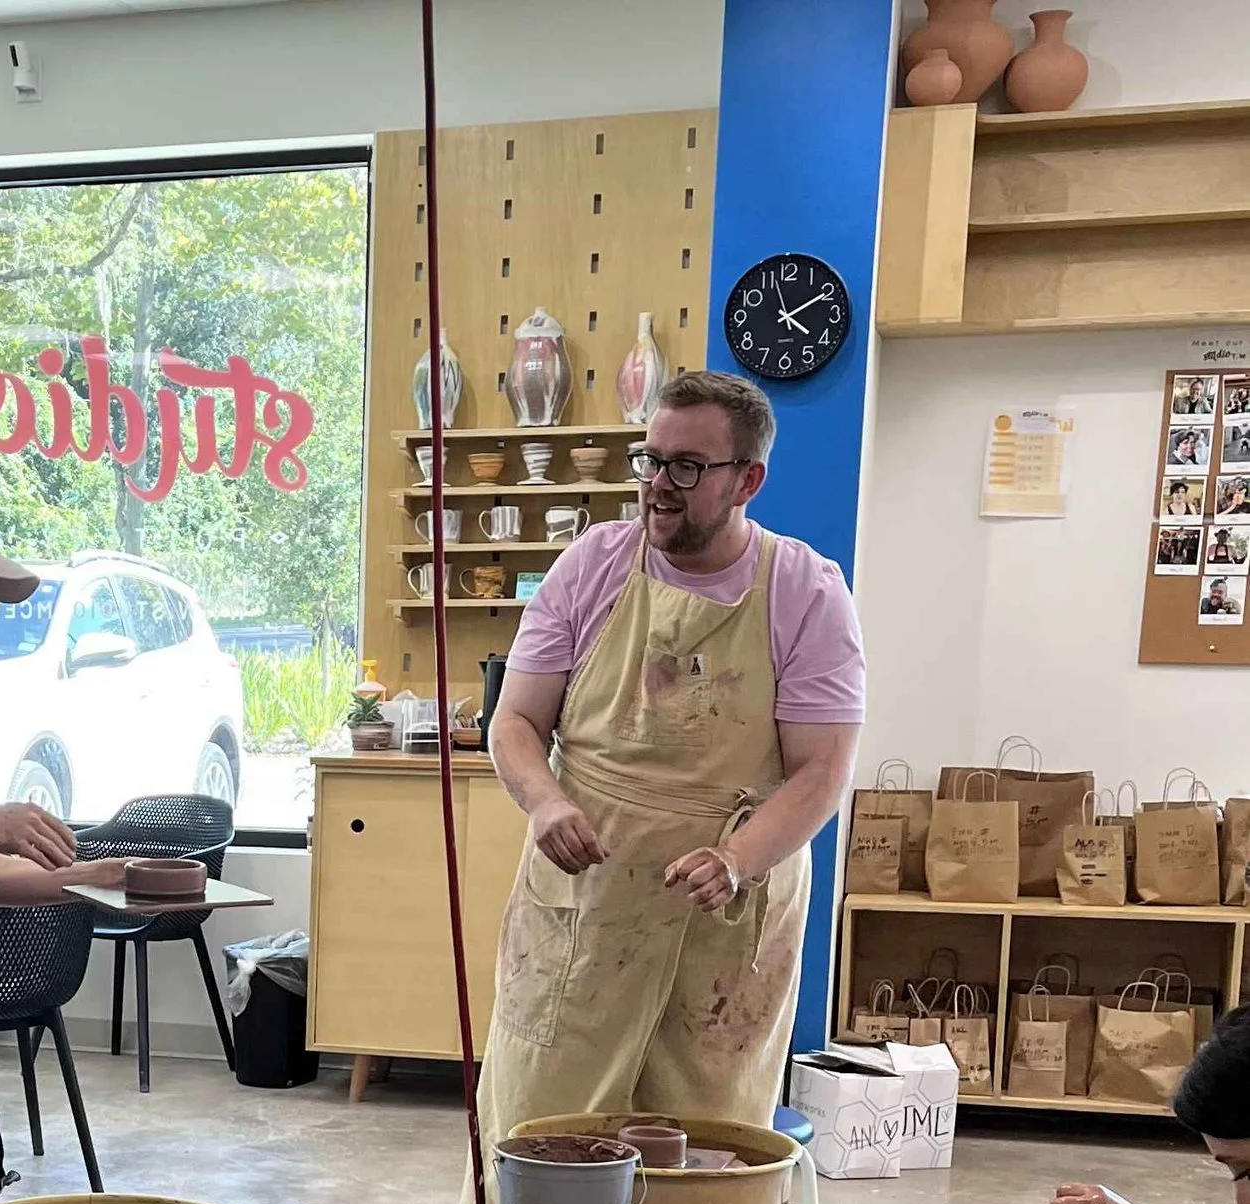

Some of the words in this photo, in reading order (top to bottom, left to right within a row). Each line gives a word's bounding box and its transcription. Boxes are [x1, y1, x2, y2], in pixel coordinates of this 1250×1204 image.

[761, 271, 774, 289] 11
[781, 263, 798, 281] 12
[743, 289, 763, 307] 10
[821, 283, 835, 301] 2
[734, 309, 747, 328] 9
[829, 305, 841, 324] 3
[741, 331, 753, 350] 8
[817, 328, 830, 346] 4
[758, 348, 770, 365] 7
[778, 351, 792, 370] 6
[802, 346, 814, 364] 5
